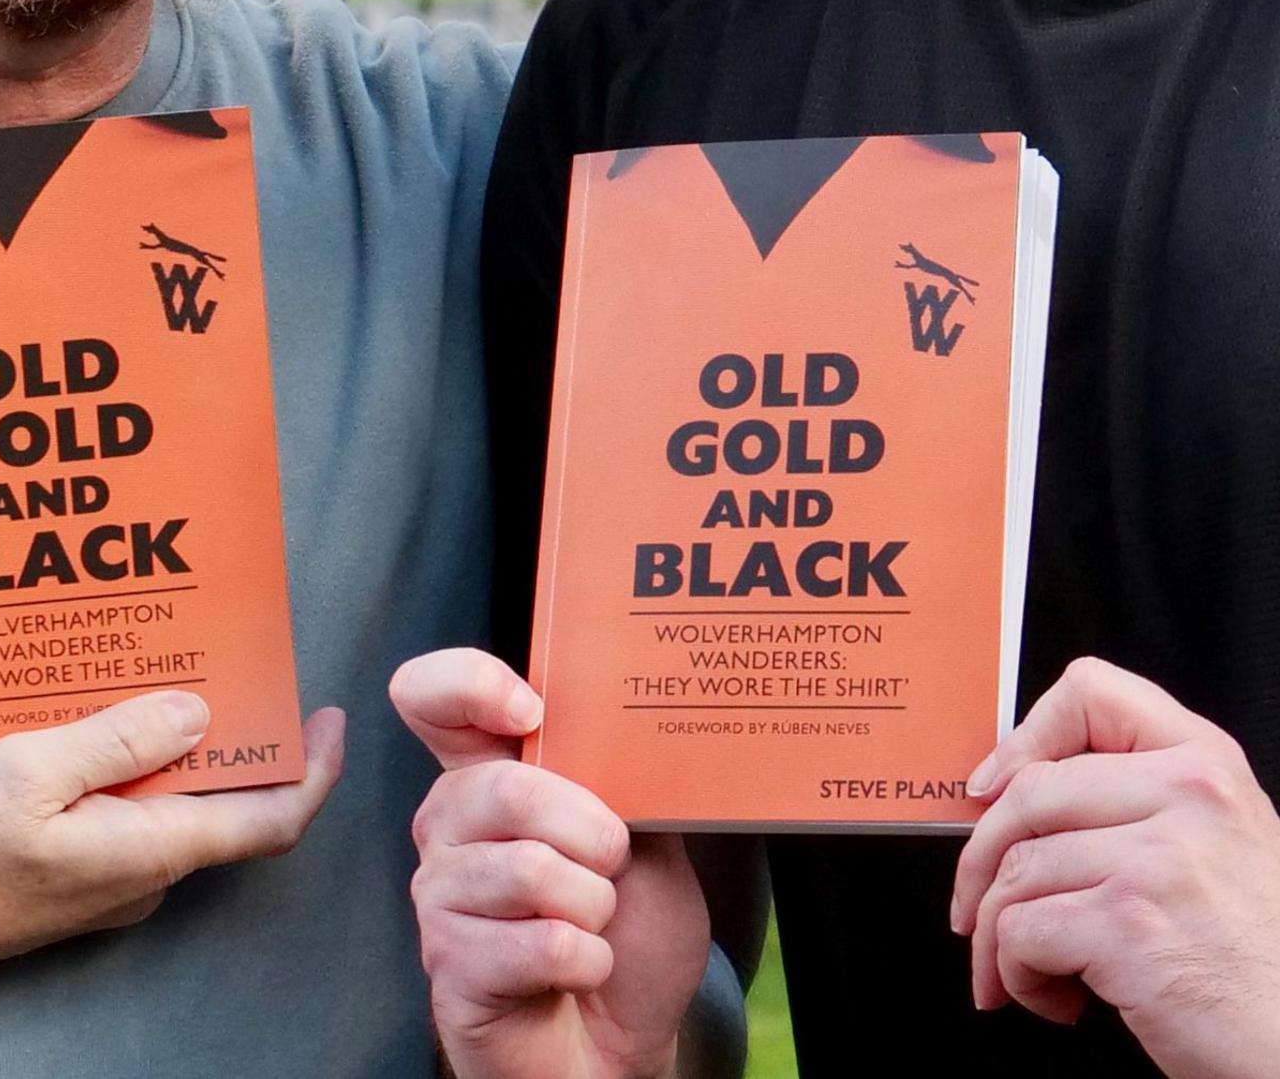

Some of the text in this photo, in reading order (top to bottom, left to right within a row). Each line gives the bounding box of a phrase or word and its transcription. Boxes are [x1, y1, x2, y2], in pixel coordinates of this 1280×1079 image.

[699, 352, 860, 410] OLD
[666, 419, 886, 476] GOLD
[700, 489, 834, 529] AND
[633, 541, 911, 598] BLACK
[655, 624, 882, 644] WOLVERHAMPTON
[78, 659, 125, 681] THE
[689, 650, 847, 670] WANDERERS:
[698, 677, 773, 697] WORE
[779, 677, 826, 697] THE
[54, 708, 70, 721] BY
[658, 719, 871, 735] FOREWORD BY RÚBEN NEVES
[206, 744, 280, 768] PLANT
[820, 779, 967, 800] STEVE PLANT
